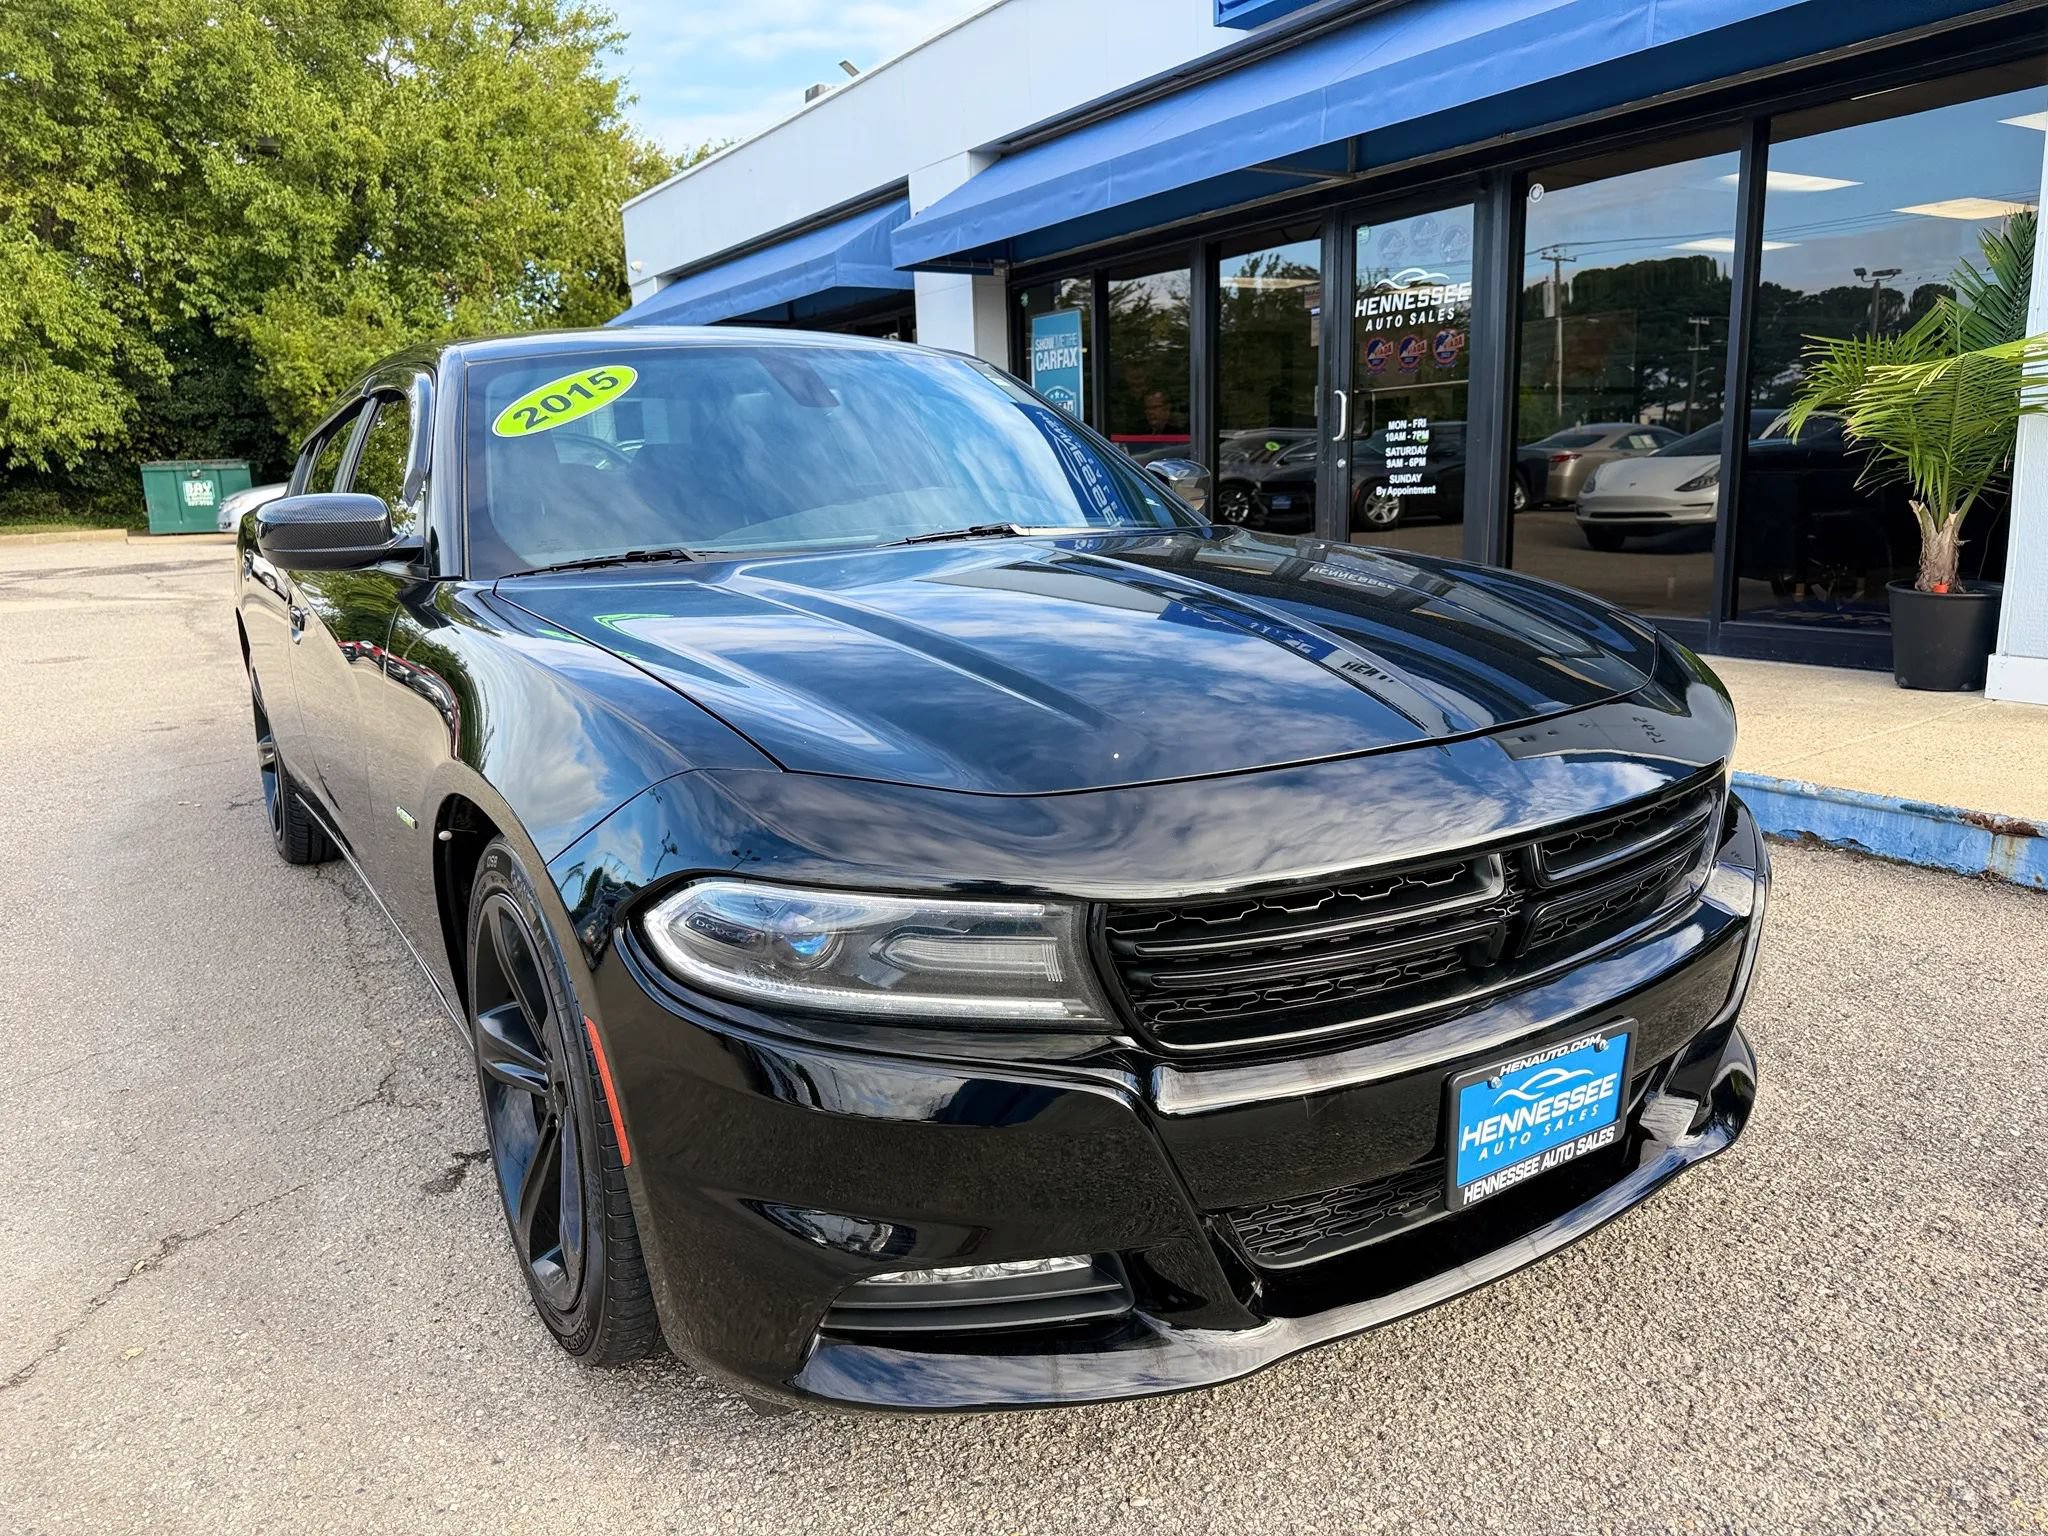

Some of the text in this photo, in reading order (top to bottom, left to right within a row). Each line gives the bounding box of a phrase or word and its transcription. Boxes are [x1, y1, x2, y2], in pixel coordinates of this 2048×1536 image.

[1355, 281, 1471, 318] HENNESSEE
[1365, 307, 1455, 332] AUTO SALES
[1035, 347, 1078, 372] CARFAX
[512, 371, 619, 430] 2015
[1385, 432, 1406, 442] 10AM
[1412, 430, 1429, 440] 7PM
[1388, 420, 1407, 430] MON
[1412, 418, 1427, 428] FRI
[1385, 445, 1428, 457] SATURDAY
[1386, 458, 1403, 468] 9AM
[1409, 457, 1426, 467] 6PM
[1389, 473, 1422, 484] SUNDAY
[1376, 485, 1436, 498] By Appointment
[1499, 1033, 1602, 1077] HENAUTO.COM
[1461, 1073, 1617, 1151] HENNESSEE
[1479, 1104, 1598, 1161] AUTO SALES
[1463, 1127, 1615, 1205] HENNESSEE AUTO SALES
